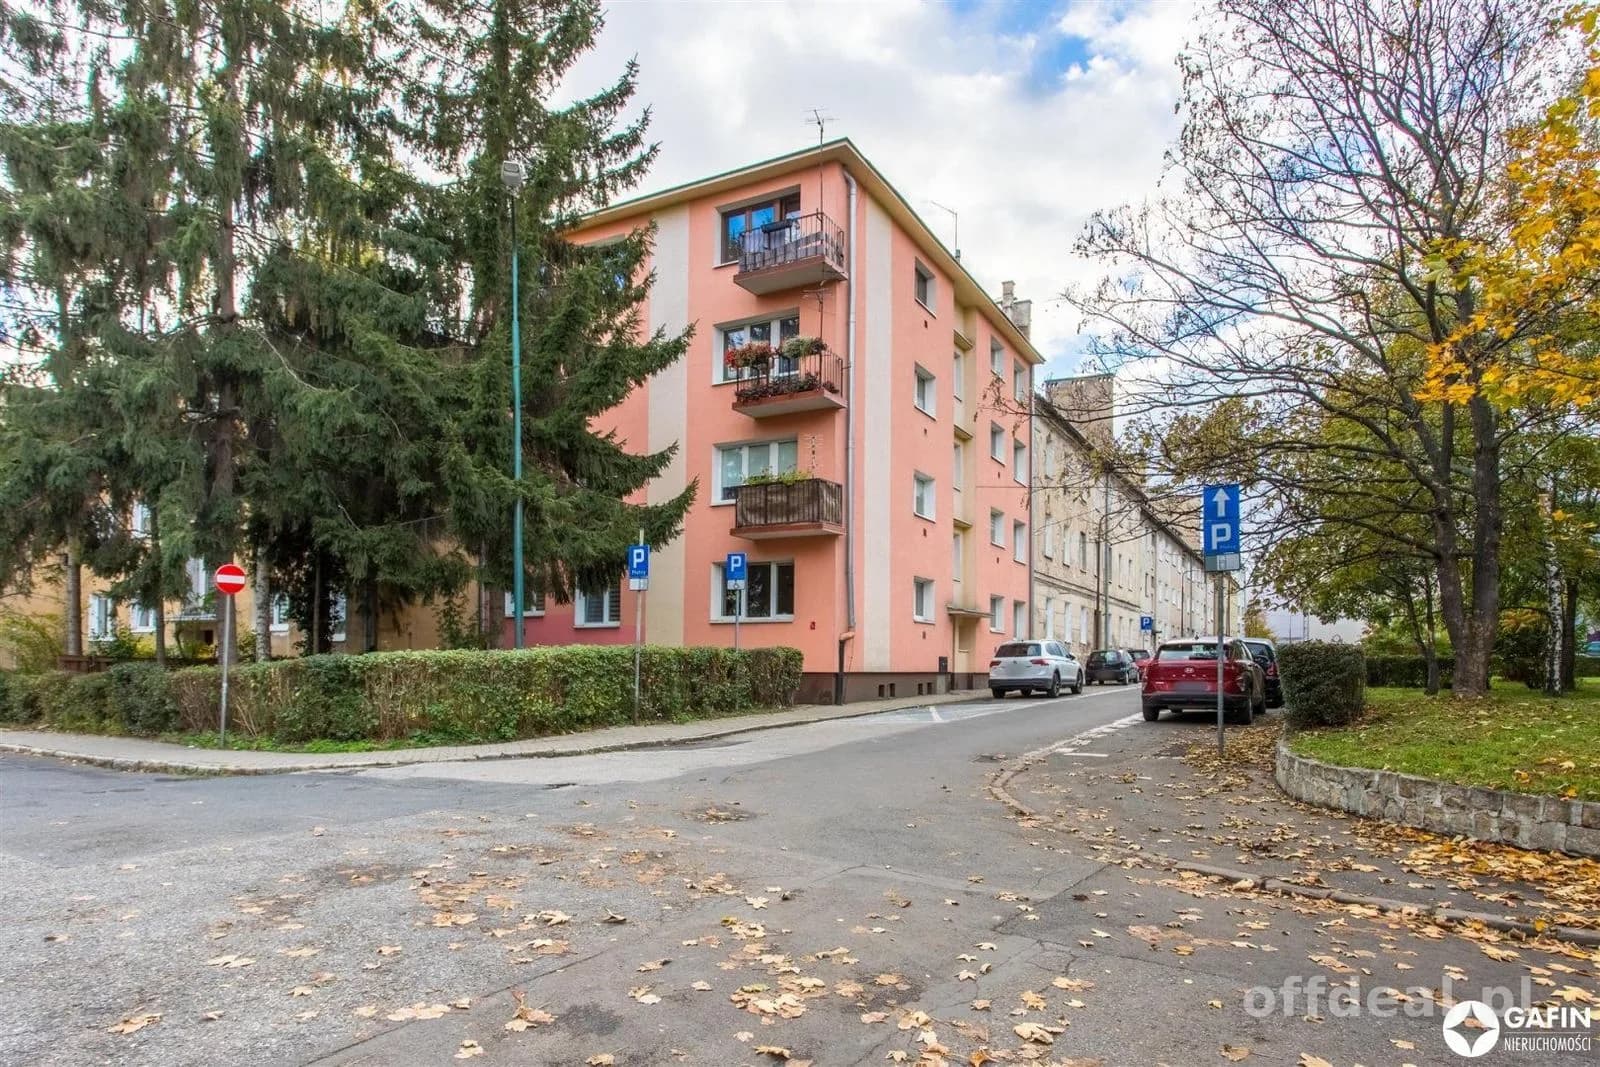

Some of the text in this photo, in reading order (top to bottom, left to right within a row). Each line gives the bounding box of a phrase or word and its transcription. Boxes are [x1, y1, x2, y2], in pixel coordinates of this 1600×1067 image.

[1211, 523, 1231, 549] P
[633, 549, 644, 568] P
[731, 555, 742, 572] P
[1143, 617, 1150, 627] P
